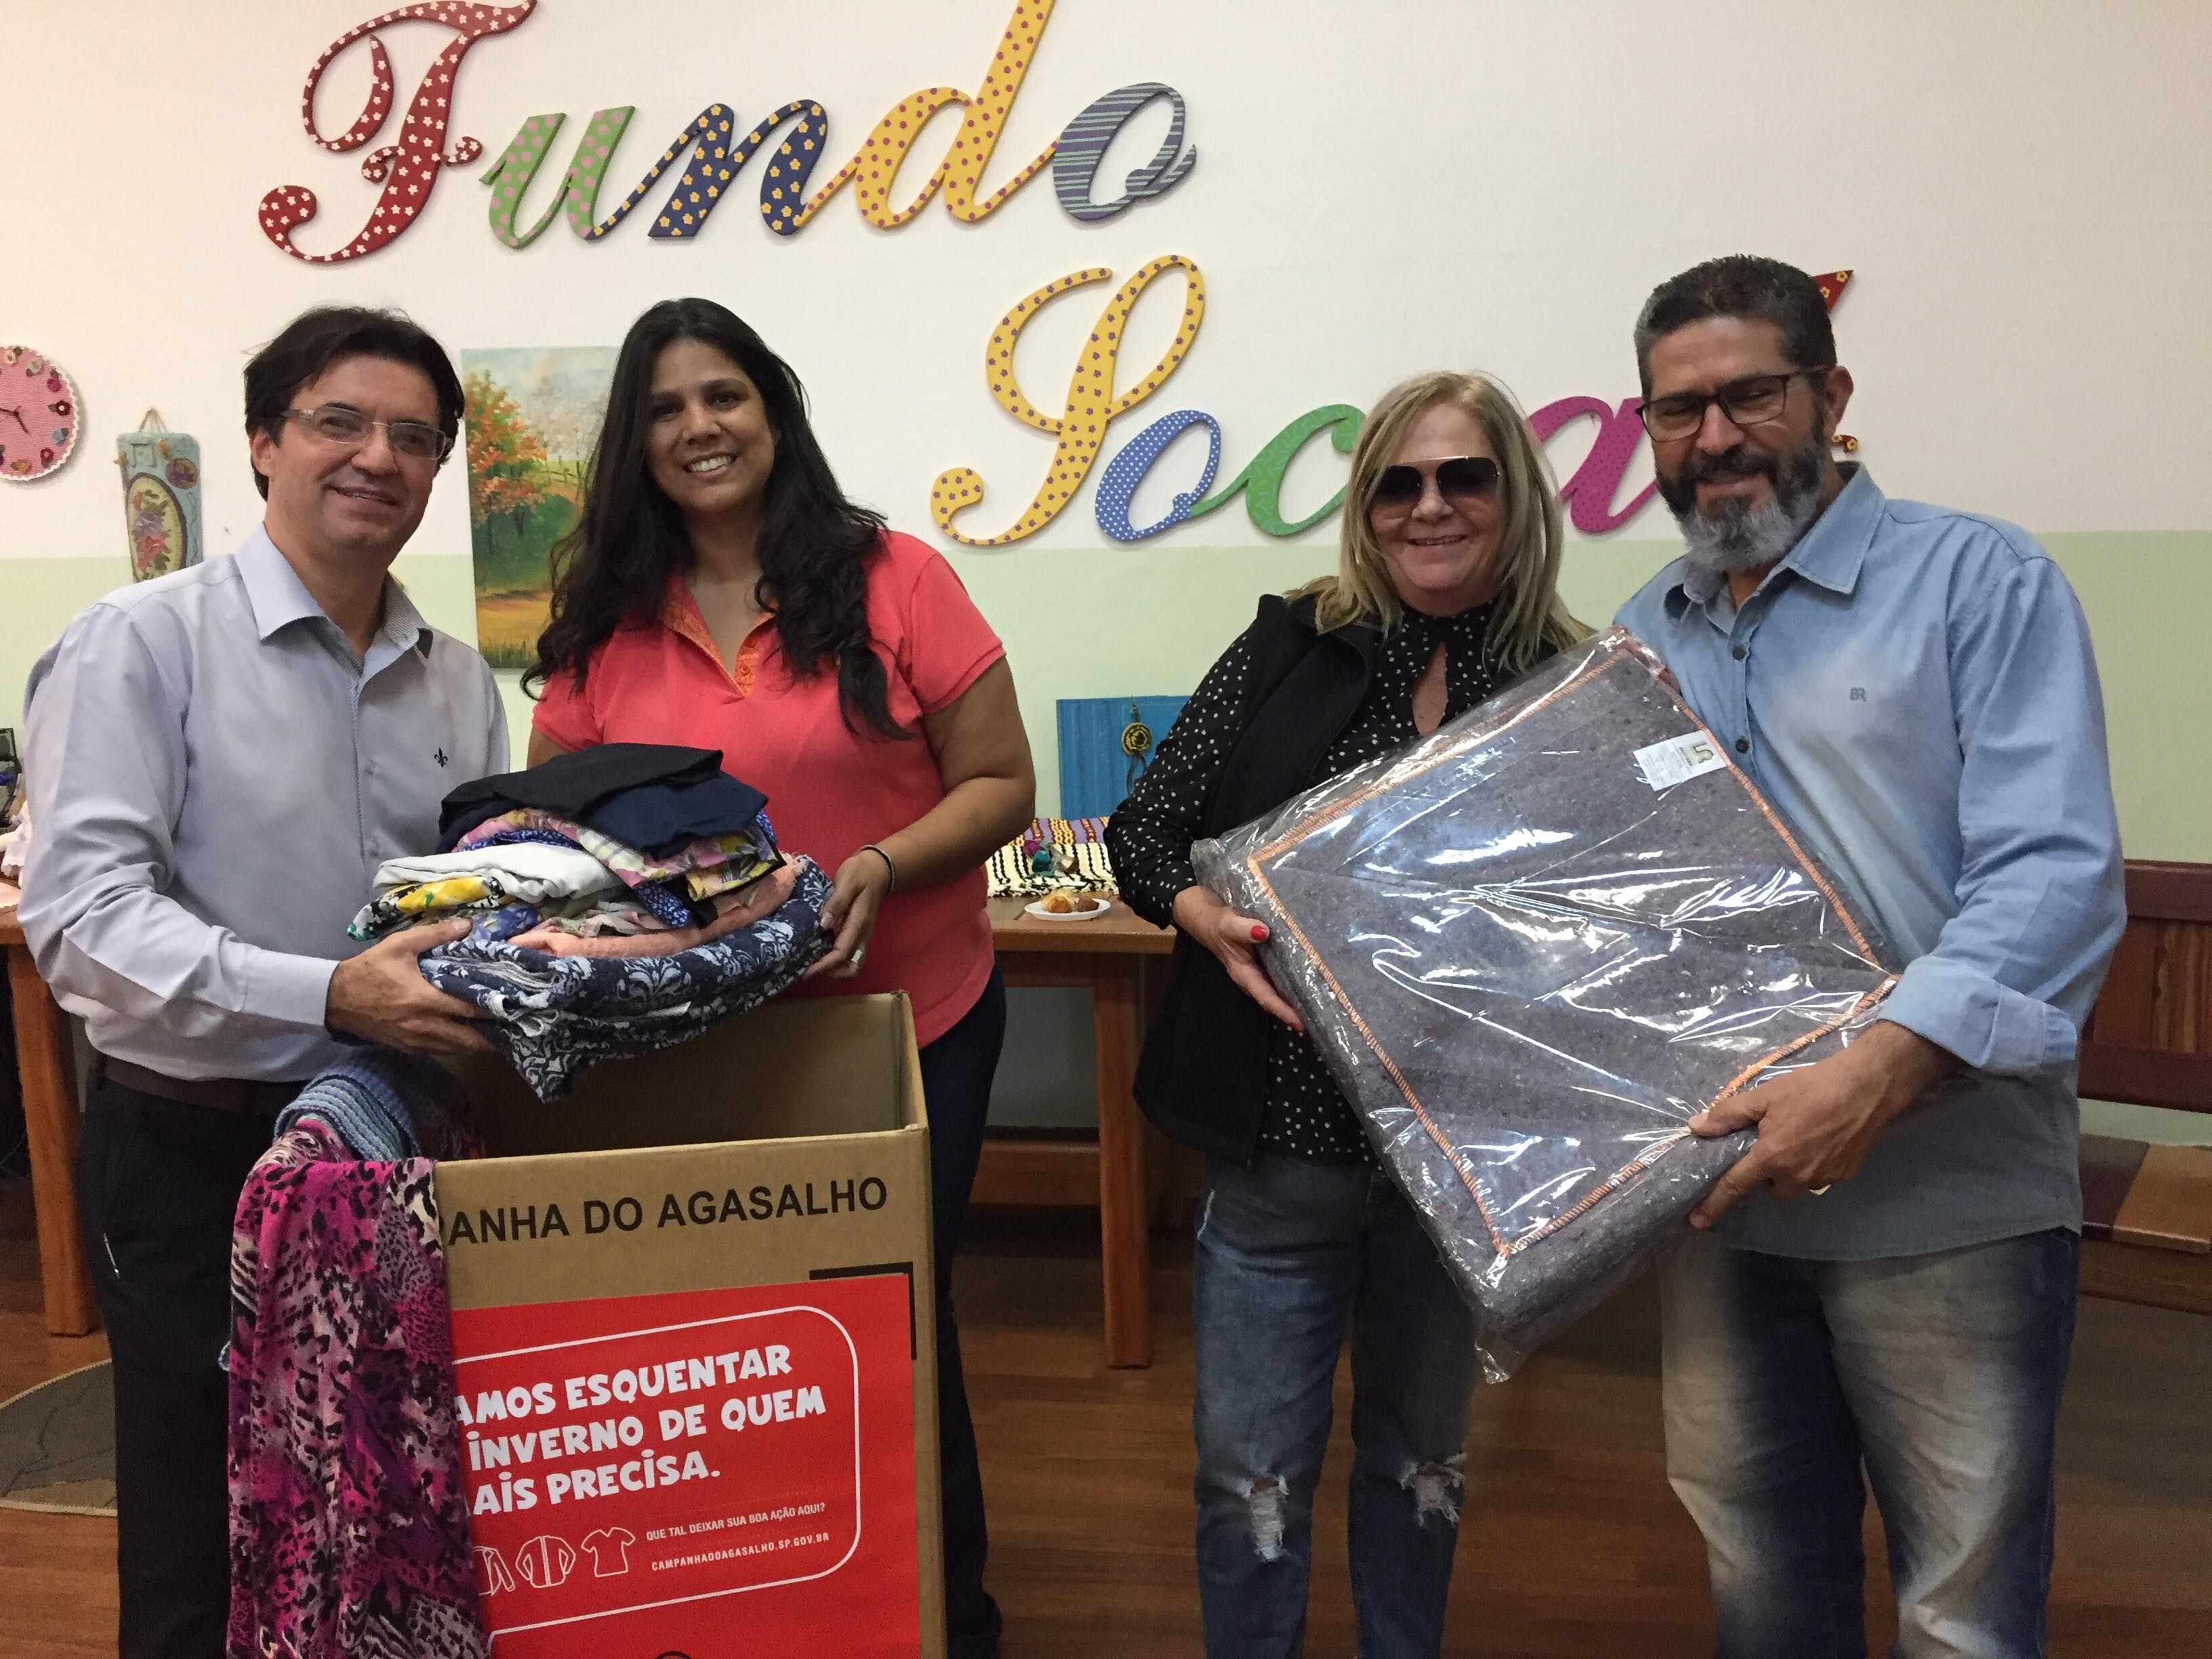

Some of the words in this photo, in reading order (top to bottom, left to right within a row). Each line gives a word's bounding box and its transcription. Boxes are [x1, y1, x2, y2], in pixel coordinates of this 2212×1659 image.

[258, 0, 1196, 263] Fundo
[931, 254, 1854, 544] Soca
[439, 1203, 570, 1246] ANHA
[583, 1197, 643, 1234] DO
[657, 1176, 887, 1228] AGASALHO
[454, 1382, 556, 1426] AMOS
[565, 1345, 792, 1410] ESQUENTAR
[466, 1415, 644, 1471] INVERNO
[659, 1404, 707, 1441] DE
[721, 1385, 827, 1433] QUEM
[465, 1471, 537, 1516] AIS
[546, 1449, 721, 1505] PRECISA.
[646, 1530, 666, 1541] QUE
[668, 1526, 687, 1537] TAL
[689, 1519, 724, 1534] DEIXAR
[726, 1515, 747, 1528] SUA
[748, 1512, 768, 1524] BOA
[771, 1507, 796, 1522] AÇÃO
[797, 1502, 825, 1516] AQUI?
[651, 1532, 830, 1572] CAMPANHADOAGASALHO.SP.GOV.BR
